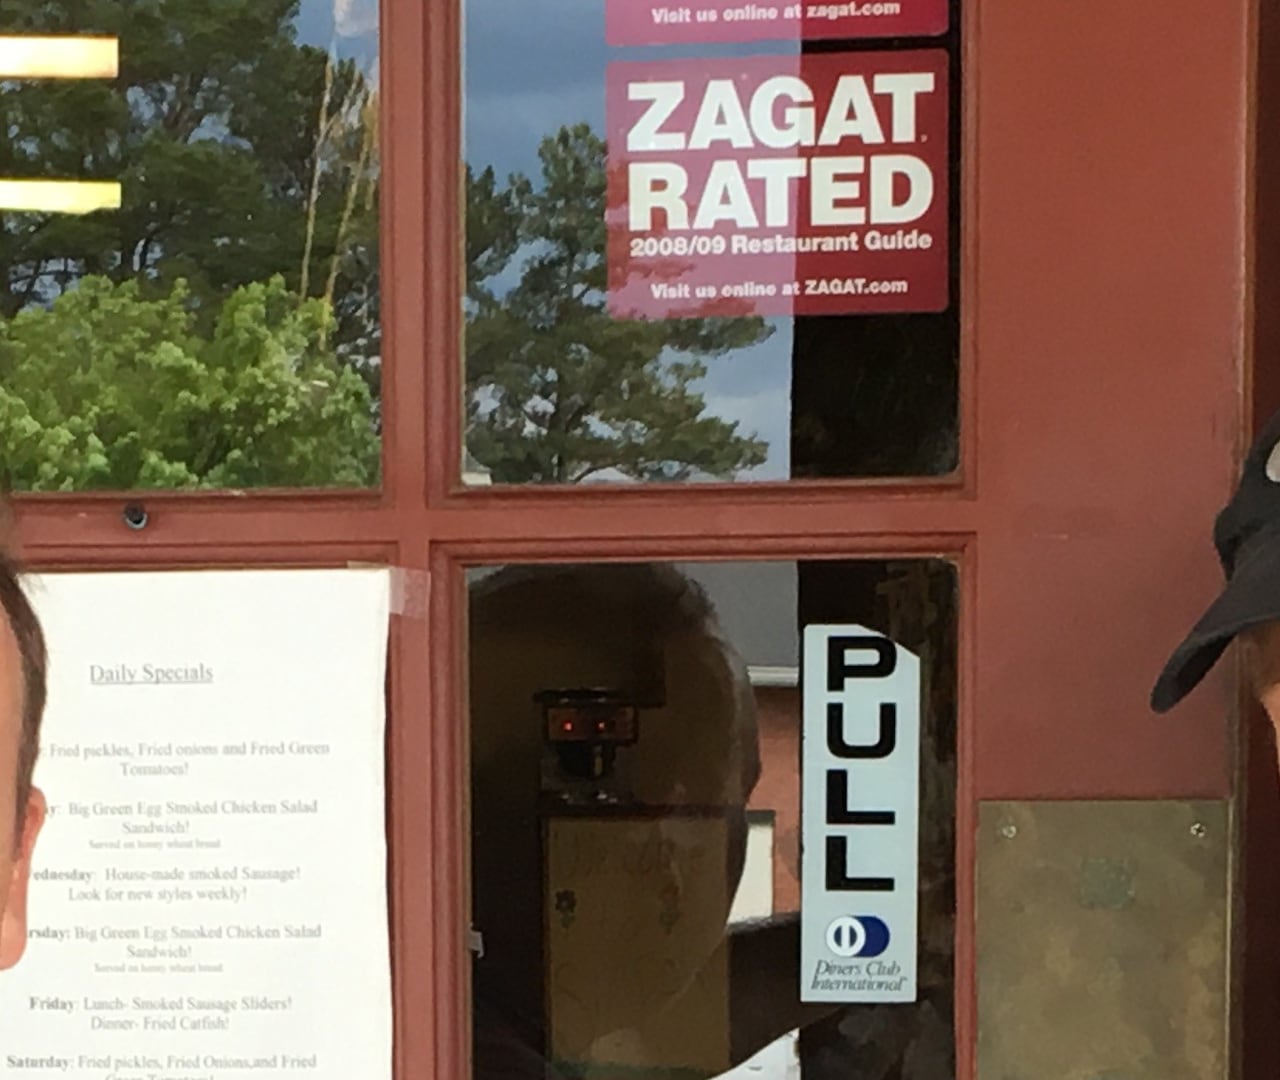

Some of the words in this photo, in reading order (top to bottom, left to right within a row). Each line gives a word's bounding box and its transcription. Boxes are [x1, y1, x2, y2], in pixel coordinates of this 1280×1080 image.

[652, 8, 690, 23] Visit
[696, 9, 718, 22] us
[723, 6, 778, 22] online
[784, 6, 802, 20] at
[807, 2, 900, 20] zagat.com
[627, 72, 935, 152] ZAGAT
[628, 155, 934, 231] RATED
[630, 236, 726, 257] 2008/09
[732, 232, 858, 254] Restaurant
[865, 230, 932, 251] Guide
[651, 283, 691, 300] Visit
[696, 285, 717, 298] us
[722, 281, 777, 298] online
[783, 282, 800, 296] at
[805, 278, 907, 296] ZAGAT.com
[90, 663, 136, 684] Daily
[143, 663, 213, 684] Specials
[50, 743, 79, 758] Fried
[138, 742, 171, 756] Fried
[176, 743, 218, 756] onions
[223, 742, 247, 756] and
[250, 741, 284, 755] Fried
[289, 741, 330, 755] Green
[120, 761, 189, 776] Tomatoes!
[826, 635, 897, 891] PULL
[69, 802, 90, 819] Big
[93, 802, 133, 816] Green
[137, 801, 162, 818] Egg
[167, 800, 217, 815] Smoked
[221, 800, 277, 814] Chicken
[280, 800, 318, 814] Salad
[122, 820, 190, 835] Sandwich!
[33, 867, 95, 885] ednesday:
[189, 866, 238, 880] smoked
[242, 866, 301, 883] Sausage!
[69, 887, 101, 901] Look
[105, 887, 123, 901] for
[127, 890, 153, 901] new
[157, 886, 193, 904] styles
[74, 925, 98, 943] Big
[101, 926, 140, 940] Green
[144, 925, 168, 942] Egg
[171, 925, 222, 939] Smoked
[226, 925, 281, 939] Chicken
[284, 924, 322, 938] Salad
[126, 944, 192, 959] Sandwich!
[816, 959, 861, 976] Diners
[865, 960, 902, 977] Club
[811, 975, 904, 991] International
[132, 996, 183, 1015] Smoked
[187, 996, 237, 1014] Sausage
[143, 1016, 176, 1031] Fried
[78, 1054, 111, 1069] Fried
[167, 1054, 200, 1070] Fried
[281, 1054, 317, 1069] Fried
